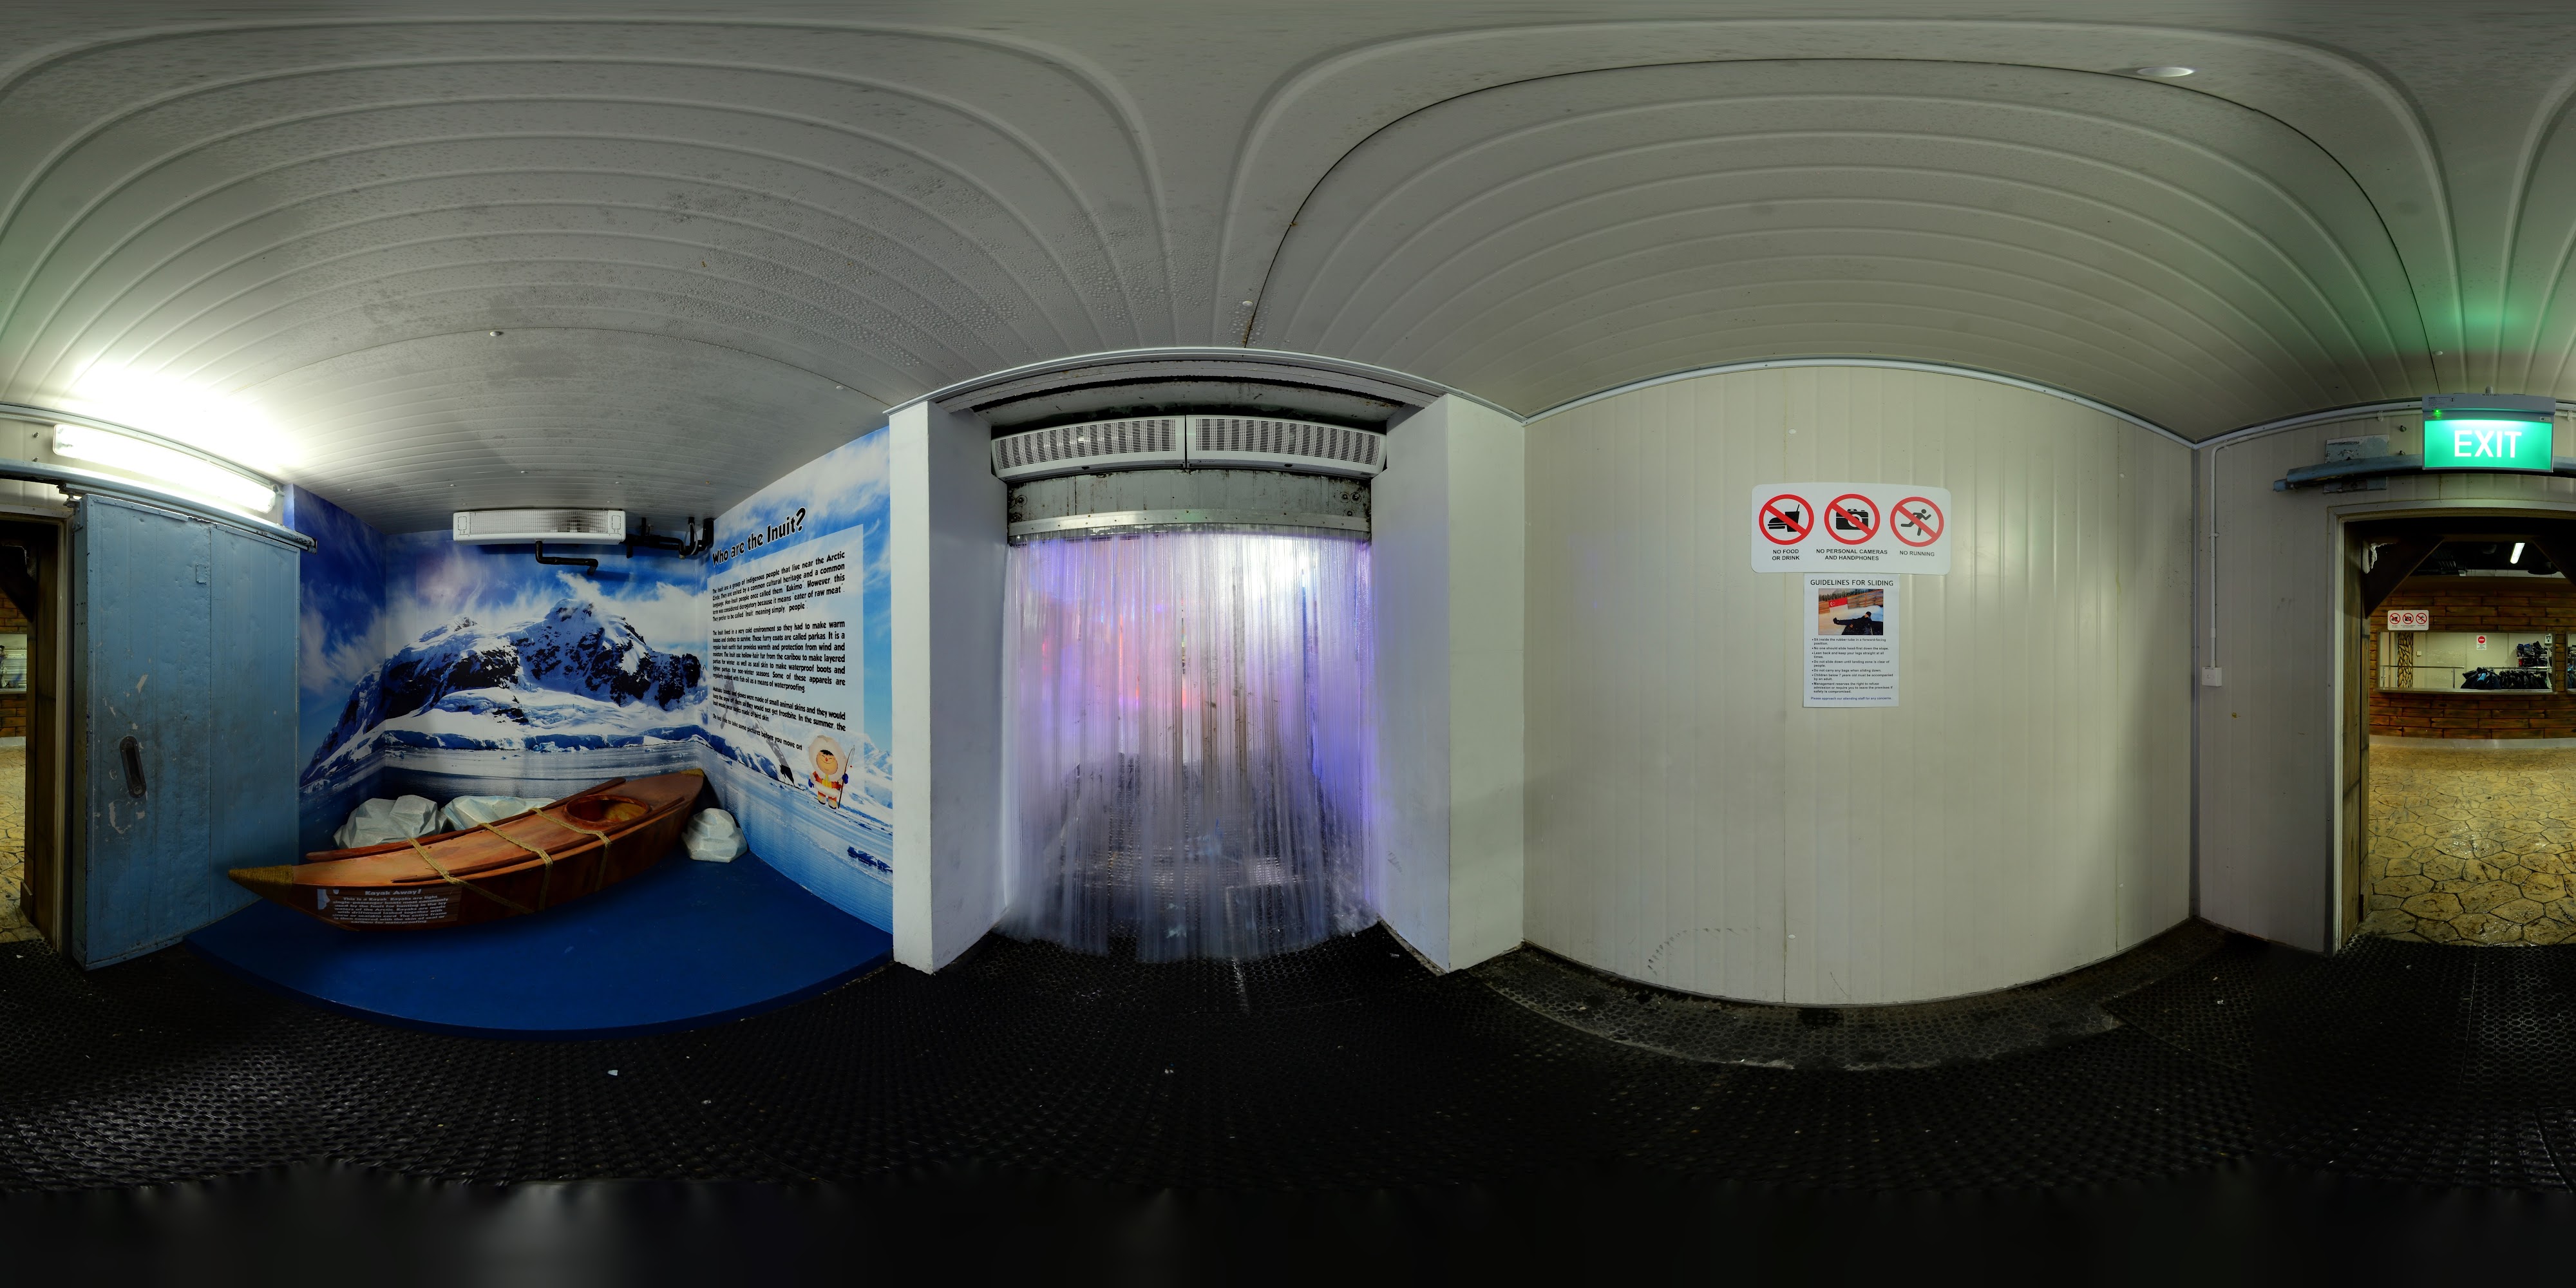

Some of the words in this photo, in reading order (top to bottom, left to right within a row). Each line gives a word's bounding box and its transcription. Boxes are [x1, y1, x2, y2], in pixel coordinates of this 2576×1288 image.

[2454, 430, 2522, 458] EXIT
[712, 549, 728, 565] Who
[731, 542, 744, 558] are
[748, 533, 763, 551] the
[767, 507, 806, 543] Inuit?
[746, 574, 764, 583] indigenous
[766, 569, 779, 579] people
[826, 551, 845, 562] Arctic
[766, 578, 781, 587] cultural
[783, 574, 802, 583] heritage
[804, 569, 813, 578] and
[820, 564, 844, 574] common
[834, 574, 845, 582] this
[789, 664, 814, 672] waterproof
[824, 654, 845, 663] layered
[794, 703, 806, 712] skins
[817, 708, 828, 717] they
[829, 712, 845, 720] would
[837, 723, 846, 731] the
[747, 726, 761, 735] pictures
[761, 730, 773, 740] before
[783, 739, 795, 748] move
